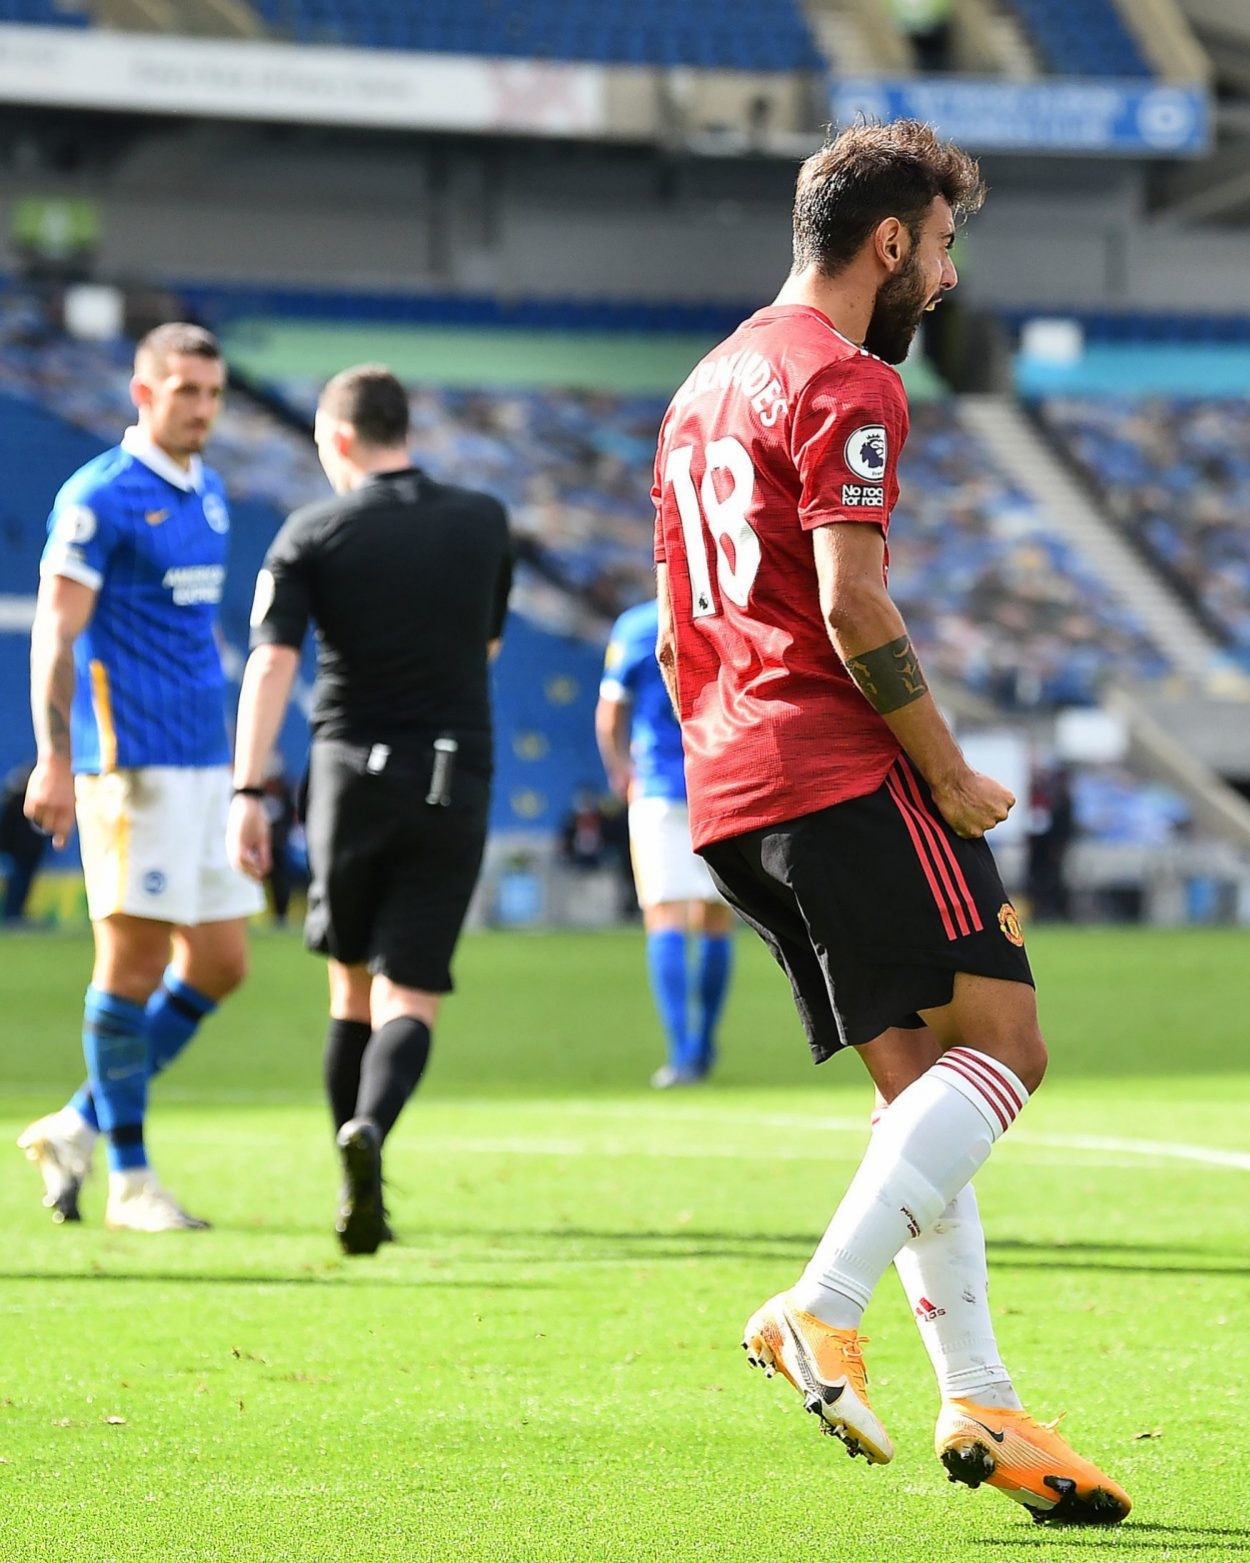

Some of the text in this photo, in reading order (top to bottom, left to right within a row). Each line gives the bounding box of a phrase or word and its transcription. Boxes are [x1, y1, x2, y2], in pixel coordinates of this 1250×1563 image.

[664, 435, 762, 618] 18
[842, 484, 884, 497] No roo
